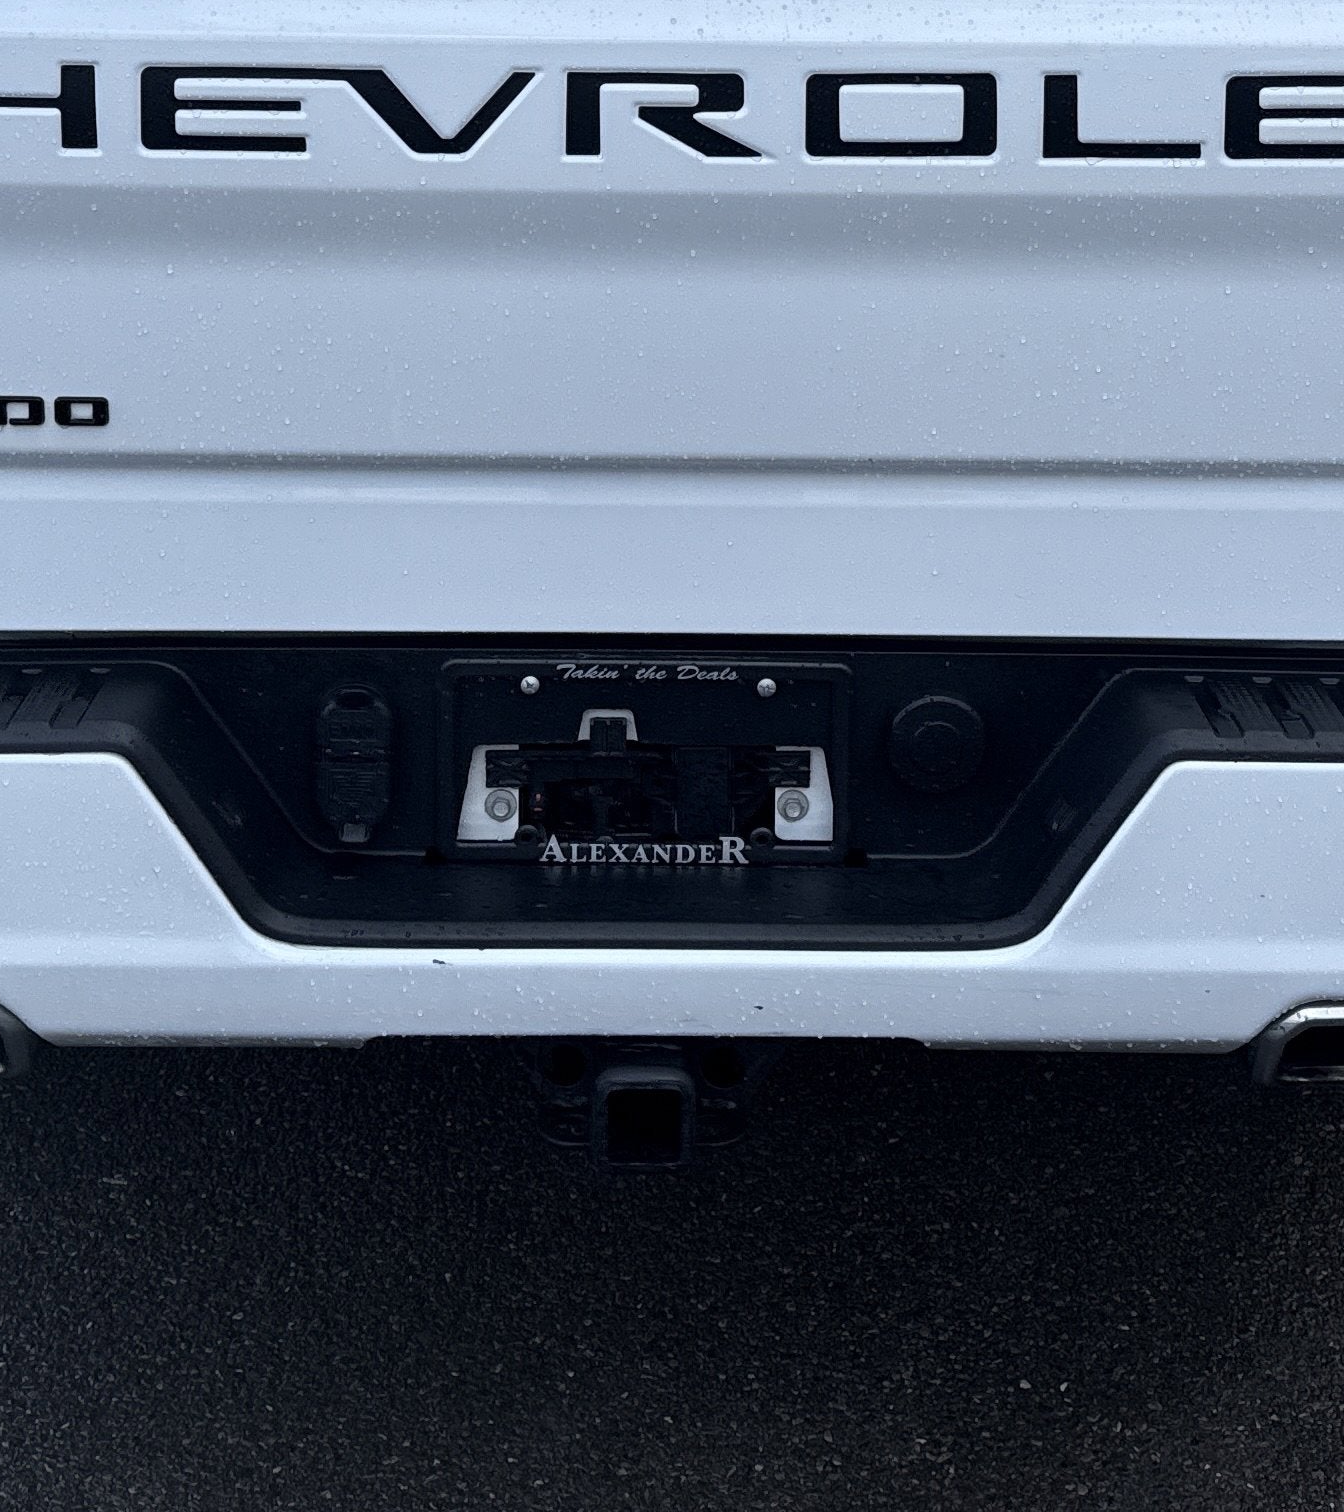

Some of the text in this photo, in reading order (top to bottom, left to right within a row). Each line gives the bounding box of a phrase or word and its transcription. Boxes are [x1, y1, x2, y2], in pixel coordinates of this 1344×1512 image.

[556, 664, 739, 681] Takin' the Deals
[538, 833, 750, 865] ALEXANDER
